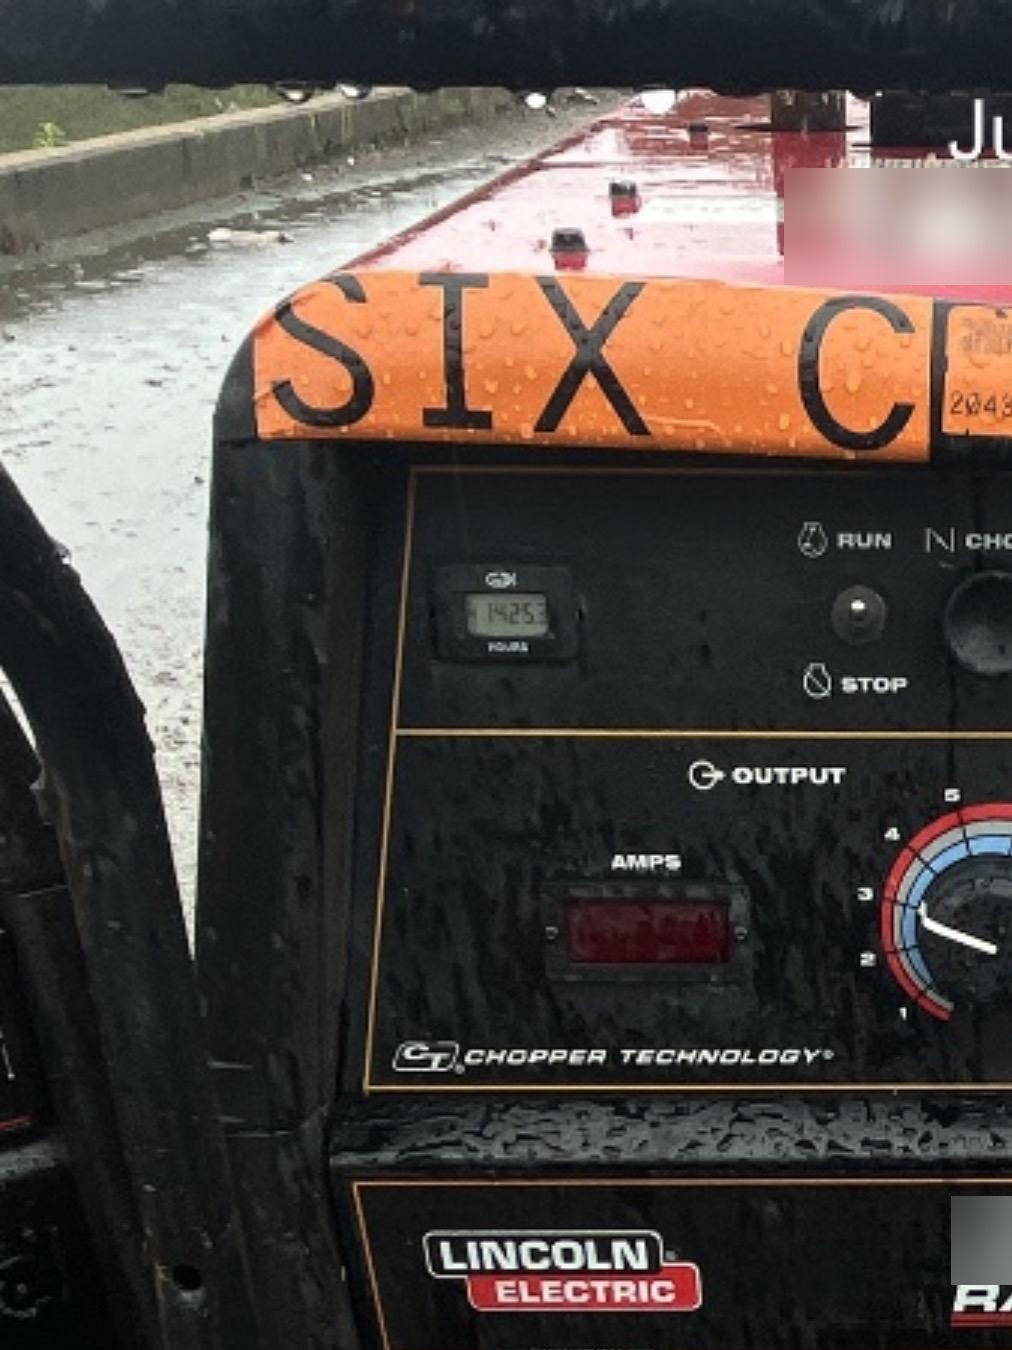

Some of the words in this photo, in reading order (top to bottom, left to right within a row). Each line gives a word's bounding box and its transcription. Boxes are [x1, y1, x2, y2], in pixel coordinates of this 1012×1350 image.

[270, 272, 650, 436] SIX
[798, 295, 917, 451] C
[836, 532, 893, 550] RUN
[840, 676, 909, 694] STOP
[731, 766, 848, 785] OUTPUT
[944, 788, 962, 802] 5
[884, 827, 901, 842] 4
[610, 853, 683, 872] AMPS
[856, 887, 875, 902] 3
[859, 953, 877, 968] 2
[898, 1007, 908, 1021] 1
[463, 1048, 607, 1066] CHOPPER
[439, 1240, 650, 1271] LINCOLN
[494, 1280, 677, 1304] ELECTRIC
